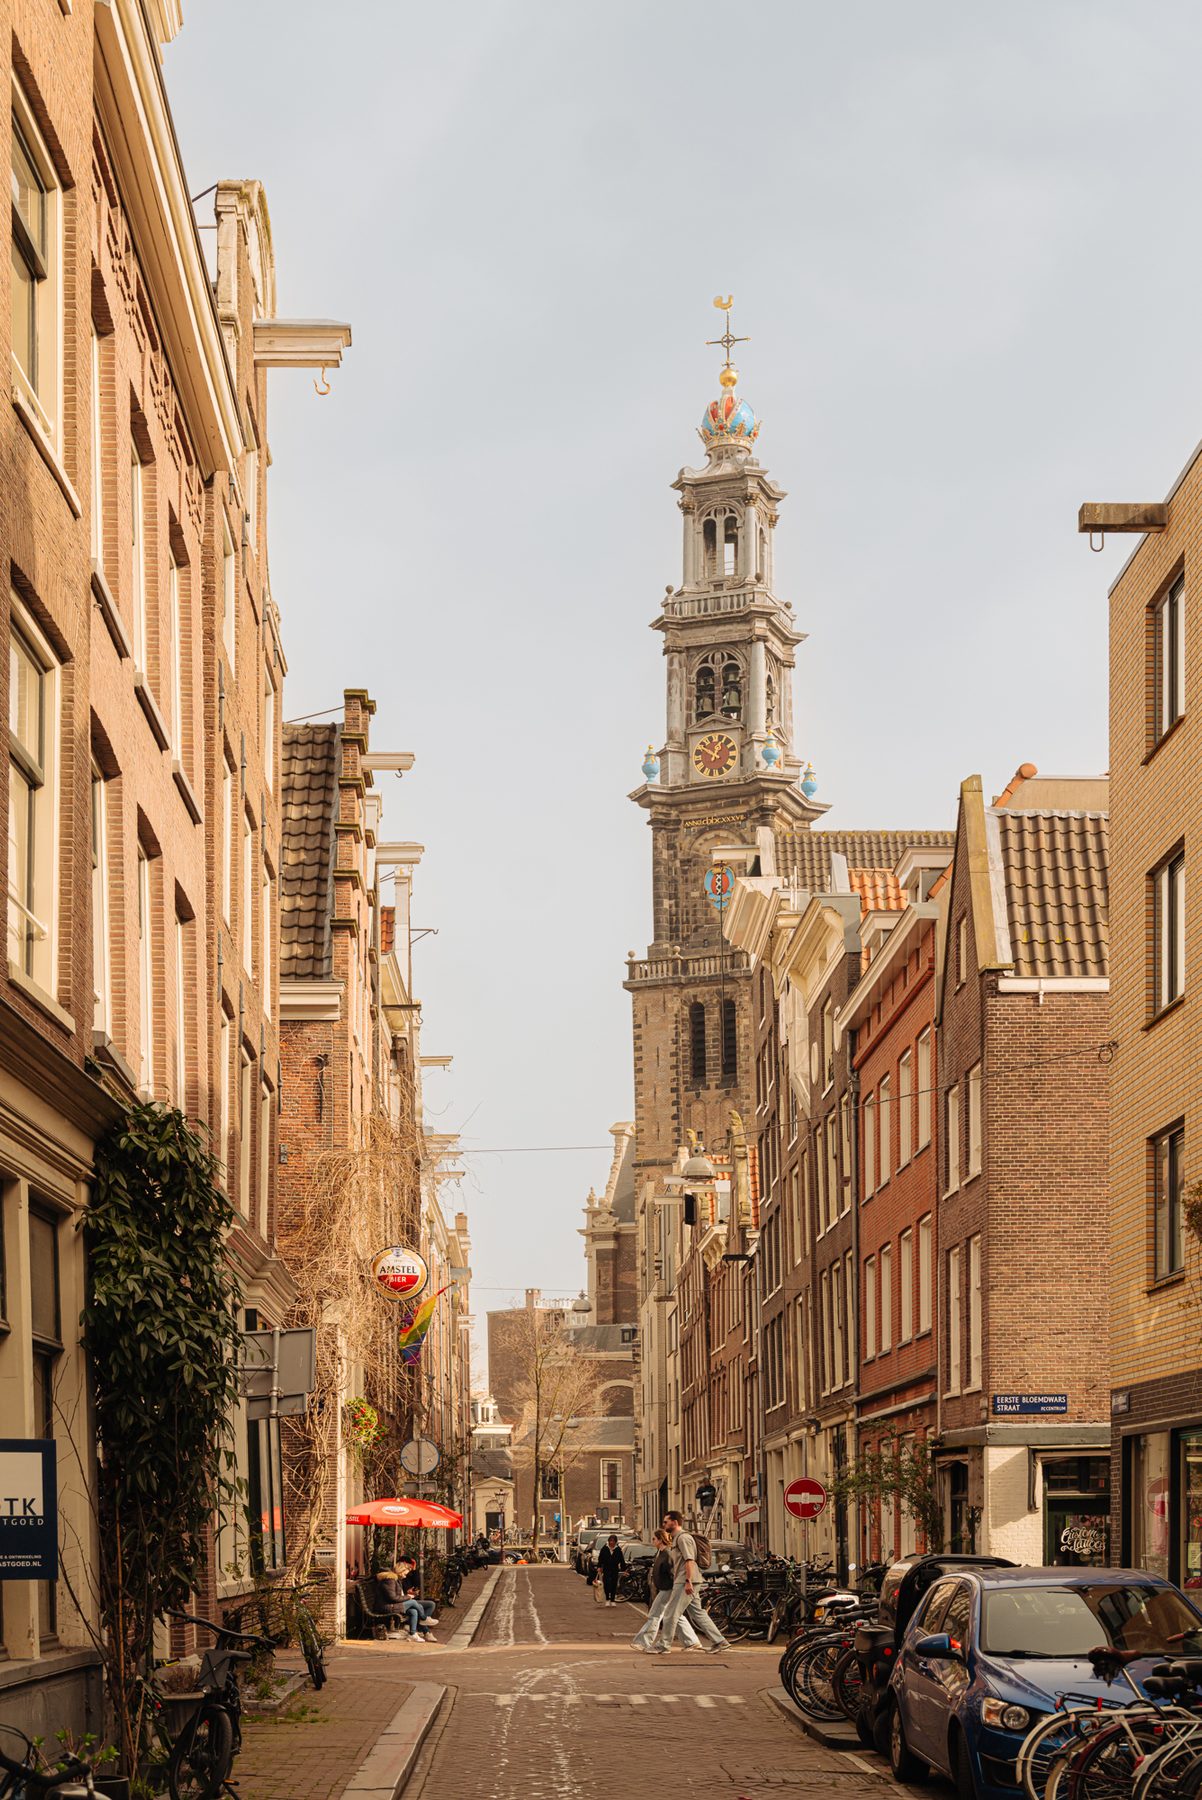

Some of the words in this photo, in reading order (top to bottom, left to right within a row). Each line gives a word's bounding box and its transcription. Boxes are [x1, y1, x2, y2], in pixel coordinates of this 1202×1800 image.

[379, 1265, 417, 1274] AMSTEL
[996, 1396, 1019, 1404] EERSTE
[0, 1498, 36, 1515] TK
